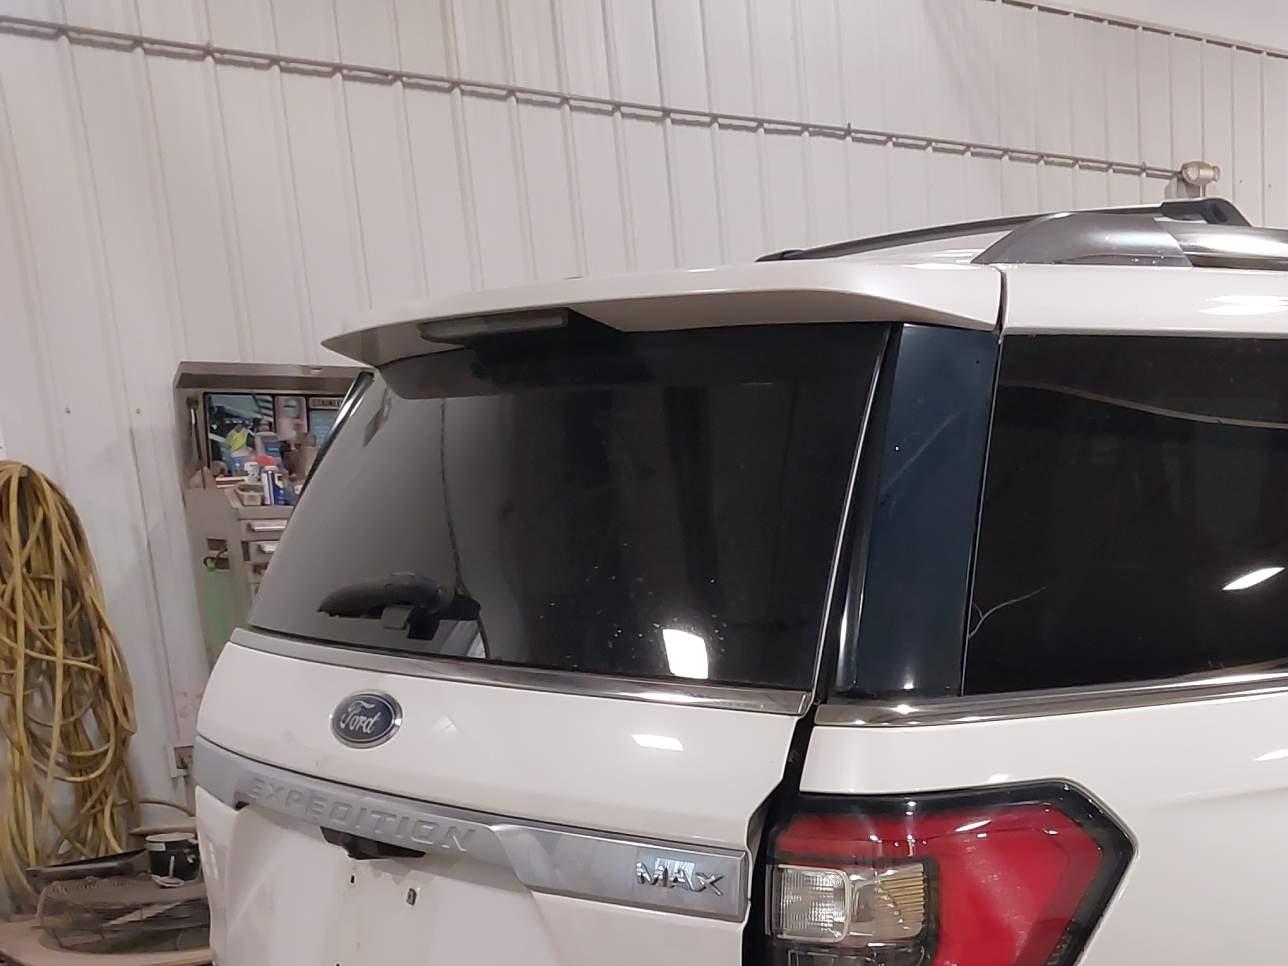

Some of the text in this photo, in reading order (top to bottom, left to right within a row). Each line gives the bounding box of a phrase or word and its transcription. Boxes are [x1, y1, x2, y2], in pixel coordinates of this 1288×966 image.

[339, 699, 382, 734] Ford
[248, 776, 724, 896] EXPEDITION MAX
